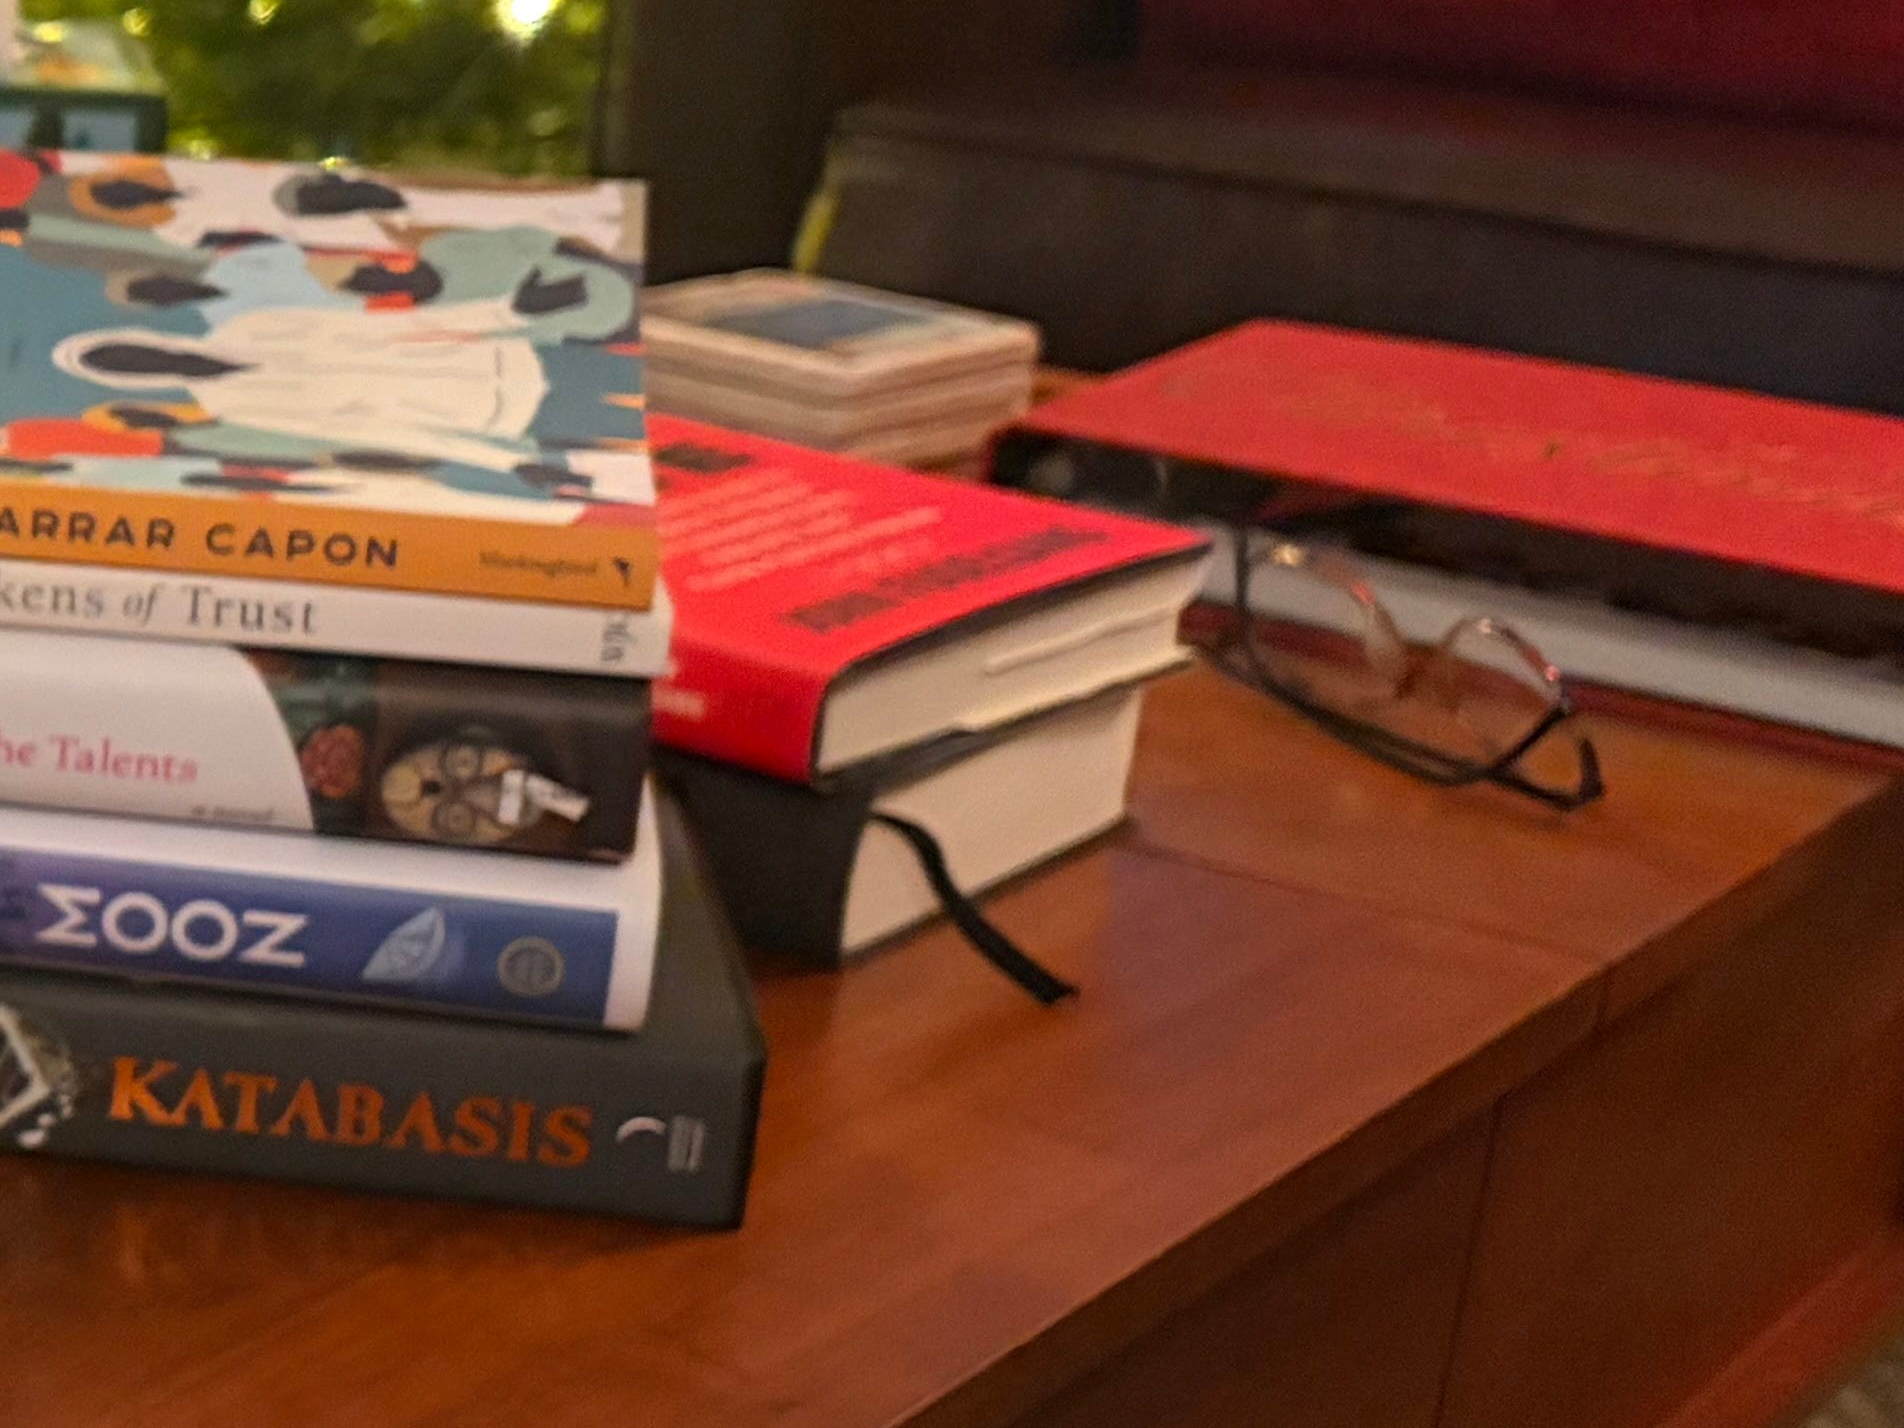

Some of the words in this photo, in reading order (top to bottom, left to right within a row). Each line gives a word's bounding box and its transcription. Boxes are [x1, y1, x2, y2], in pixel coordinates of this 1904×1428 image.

[204, 522, 400, 567] CAPON
[120, 576, 163, 620] of
[182, 584, 319, 636] Trust
[48, 734, 201, 786] Talents
[36, 882, 309, 969] MOON
[107, 1055, 593, 1168] KATABASIS
